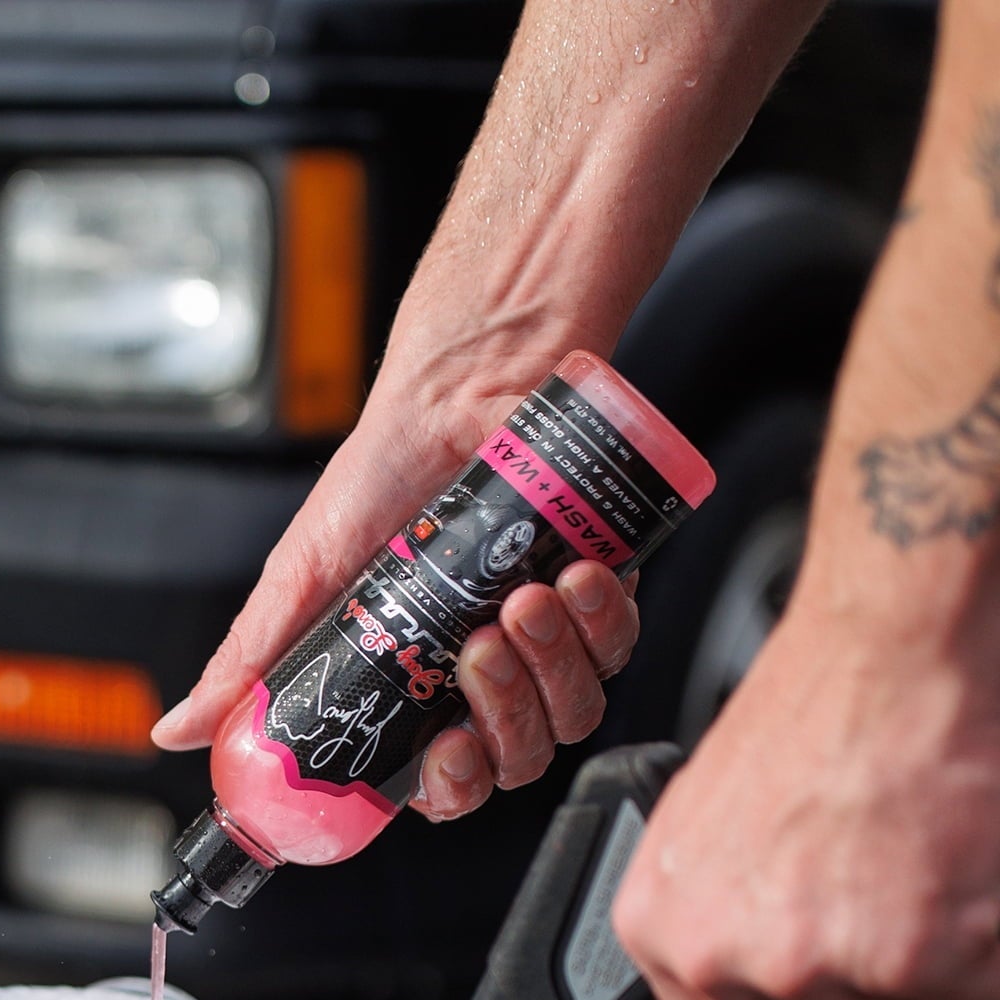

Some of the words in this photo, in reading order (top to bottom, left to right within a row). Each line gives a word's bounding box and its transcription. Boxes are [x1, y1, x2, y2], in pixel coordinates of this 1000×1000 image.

[522, 421, 542, 440] ONE
[534, 411, 566, 438] GLOSS
[490, 438, 540, 484] WAX
[540, 441, 555, 453] IN
[564, 439, 592, 465] HIGH
[553, 454, 602, 501] PROTECT
[591, 465, 603, 475] A
[602, 476, 641, 515] LEAVES
[547, 495, 617, 560] WASH
[611, 511, 638, 537] WASH
[342, 598, 398, 656] Leno's
[396, 644, 445, 700] Jay
